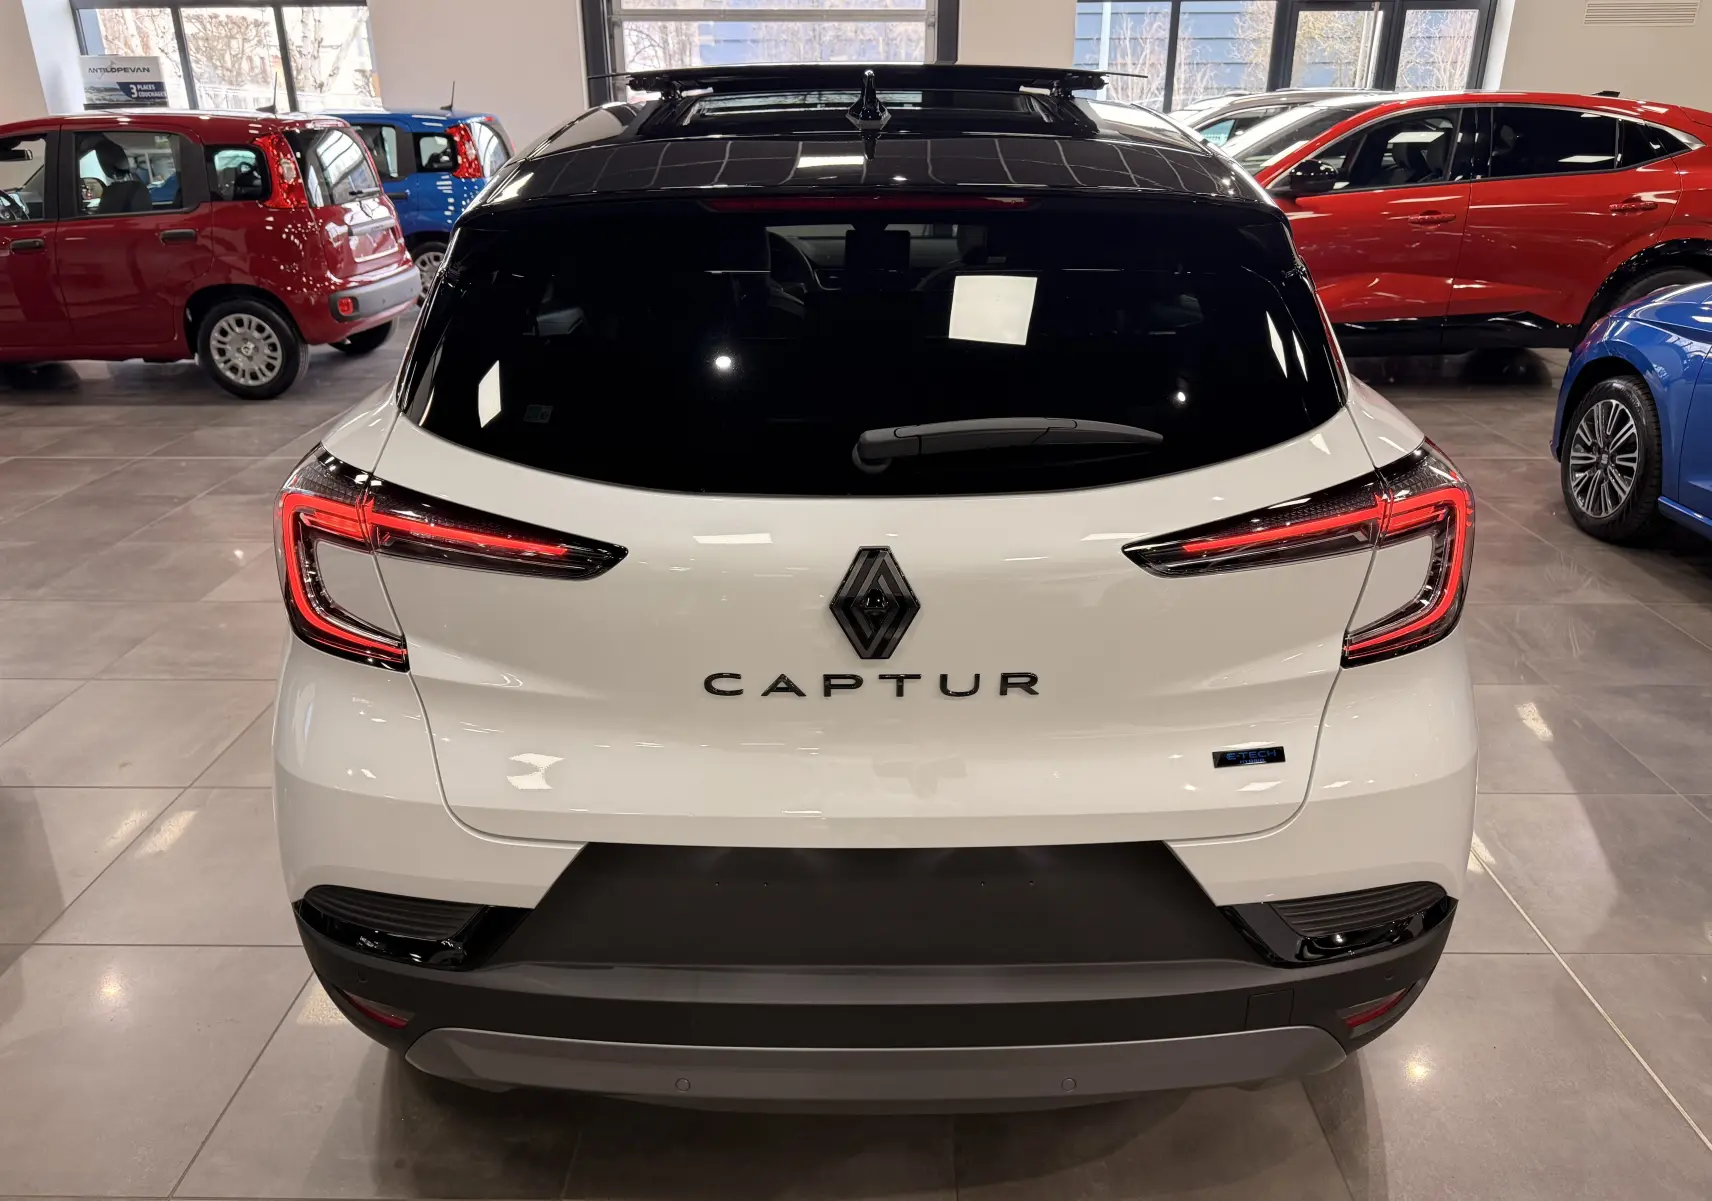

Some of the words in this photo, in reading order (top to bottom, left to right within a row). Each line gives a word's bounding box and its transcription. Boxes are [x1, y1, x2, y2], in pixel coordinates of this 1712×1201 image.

[129, 84, 138, 98] 3
[703, 673, 1039, 697] CAPTUR
[1226, 750, 1277, 760] E-TECH
